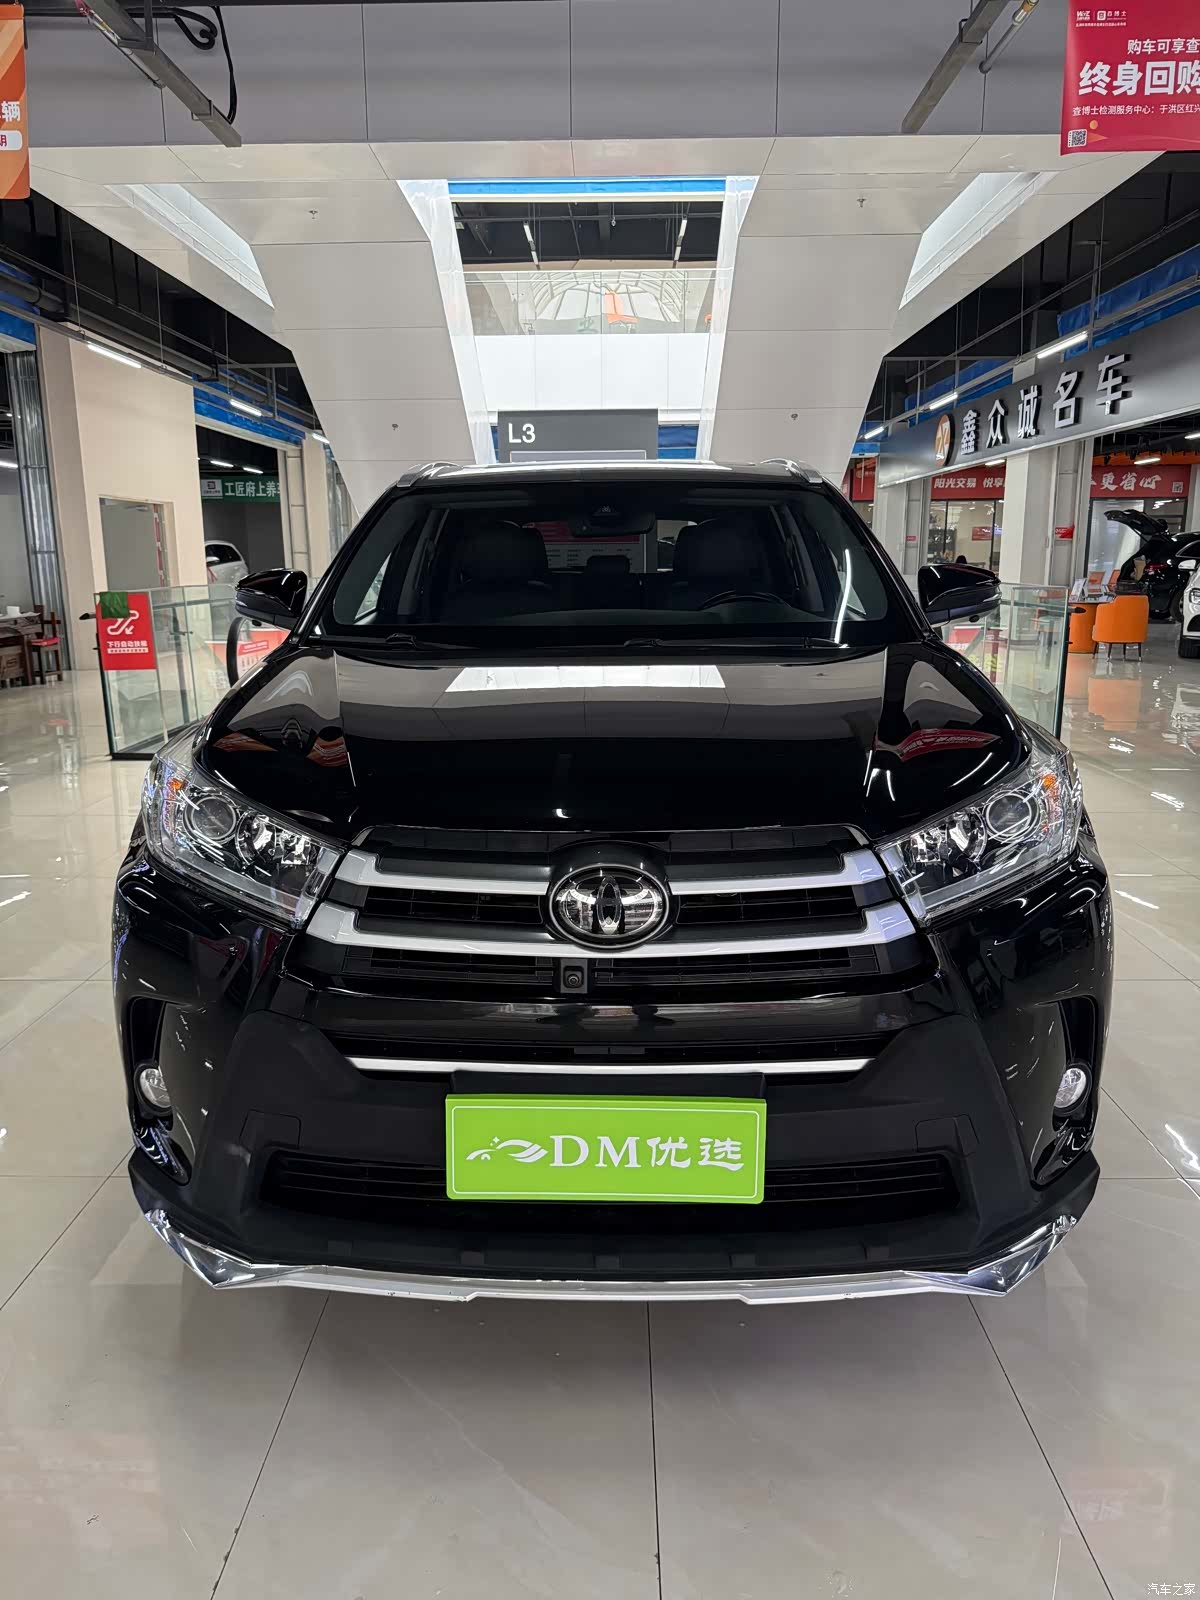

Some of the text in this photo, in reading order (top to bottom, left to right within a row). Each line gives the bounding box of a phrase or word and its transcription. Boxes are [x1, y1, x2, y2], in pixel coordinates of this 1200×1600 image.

[1127, 37, 1200, 55] 购车可享查
[1078, 60, 1200, 96] 终身回购
[0, 101, 21, 122] 辆
[961, 353, 1125, 455] 鑫众诚名车
[508, 422, 536, 444] L3
[934, 477, 1005, 489] 阳光交易 悦享
